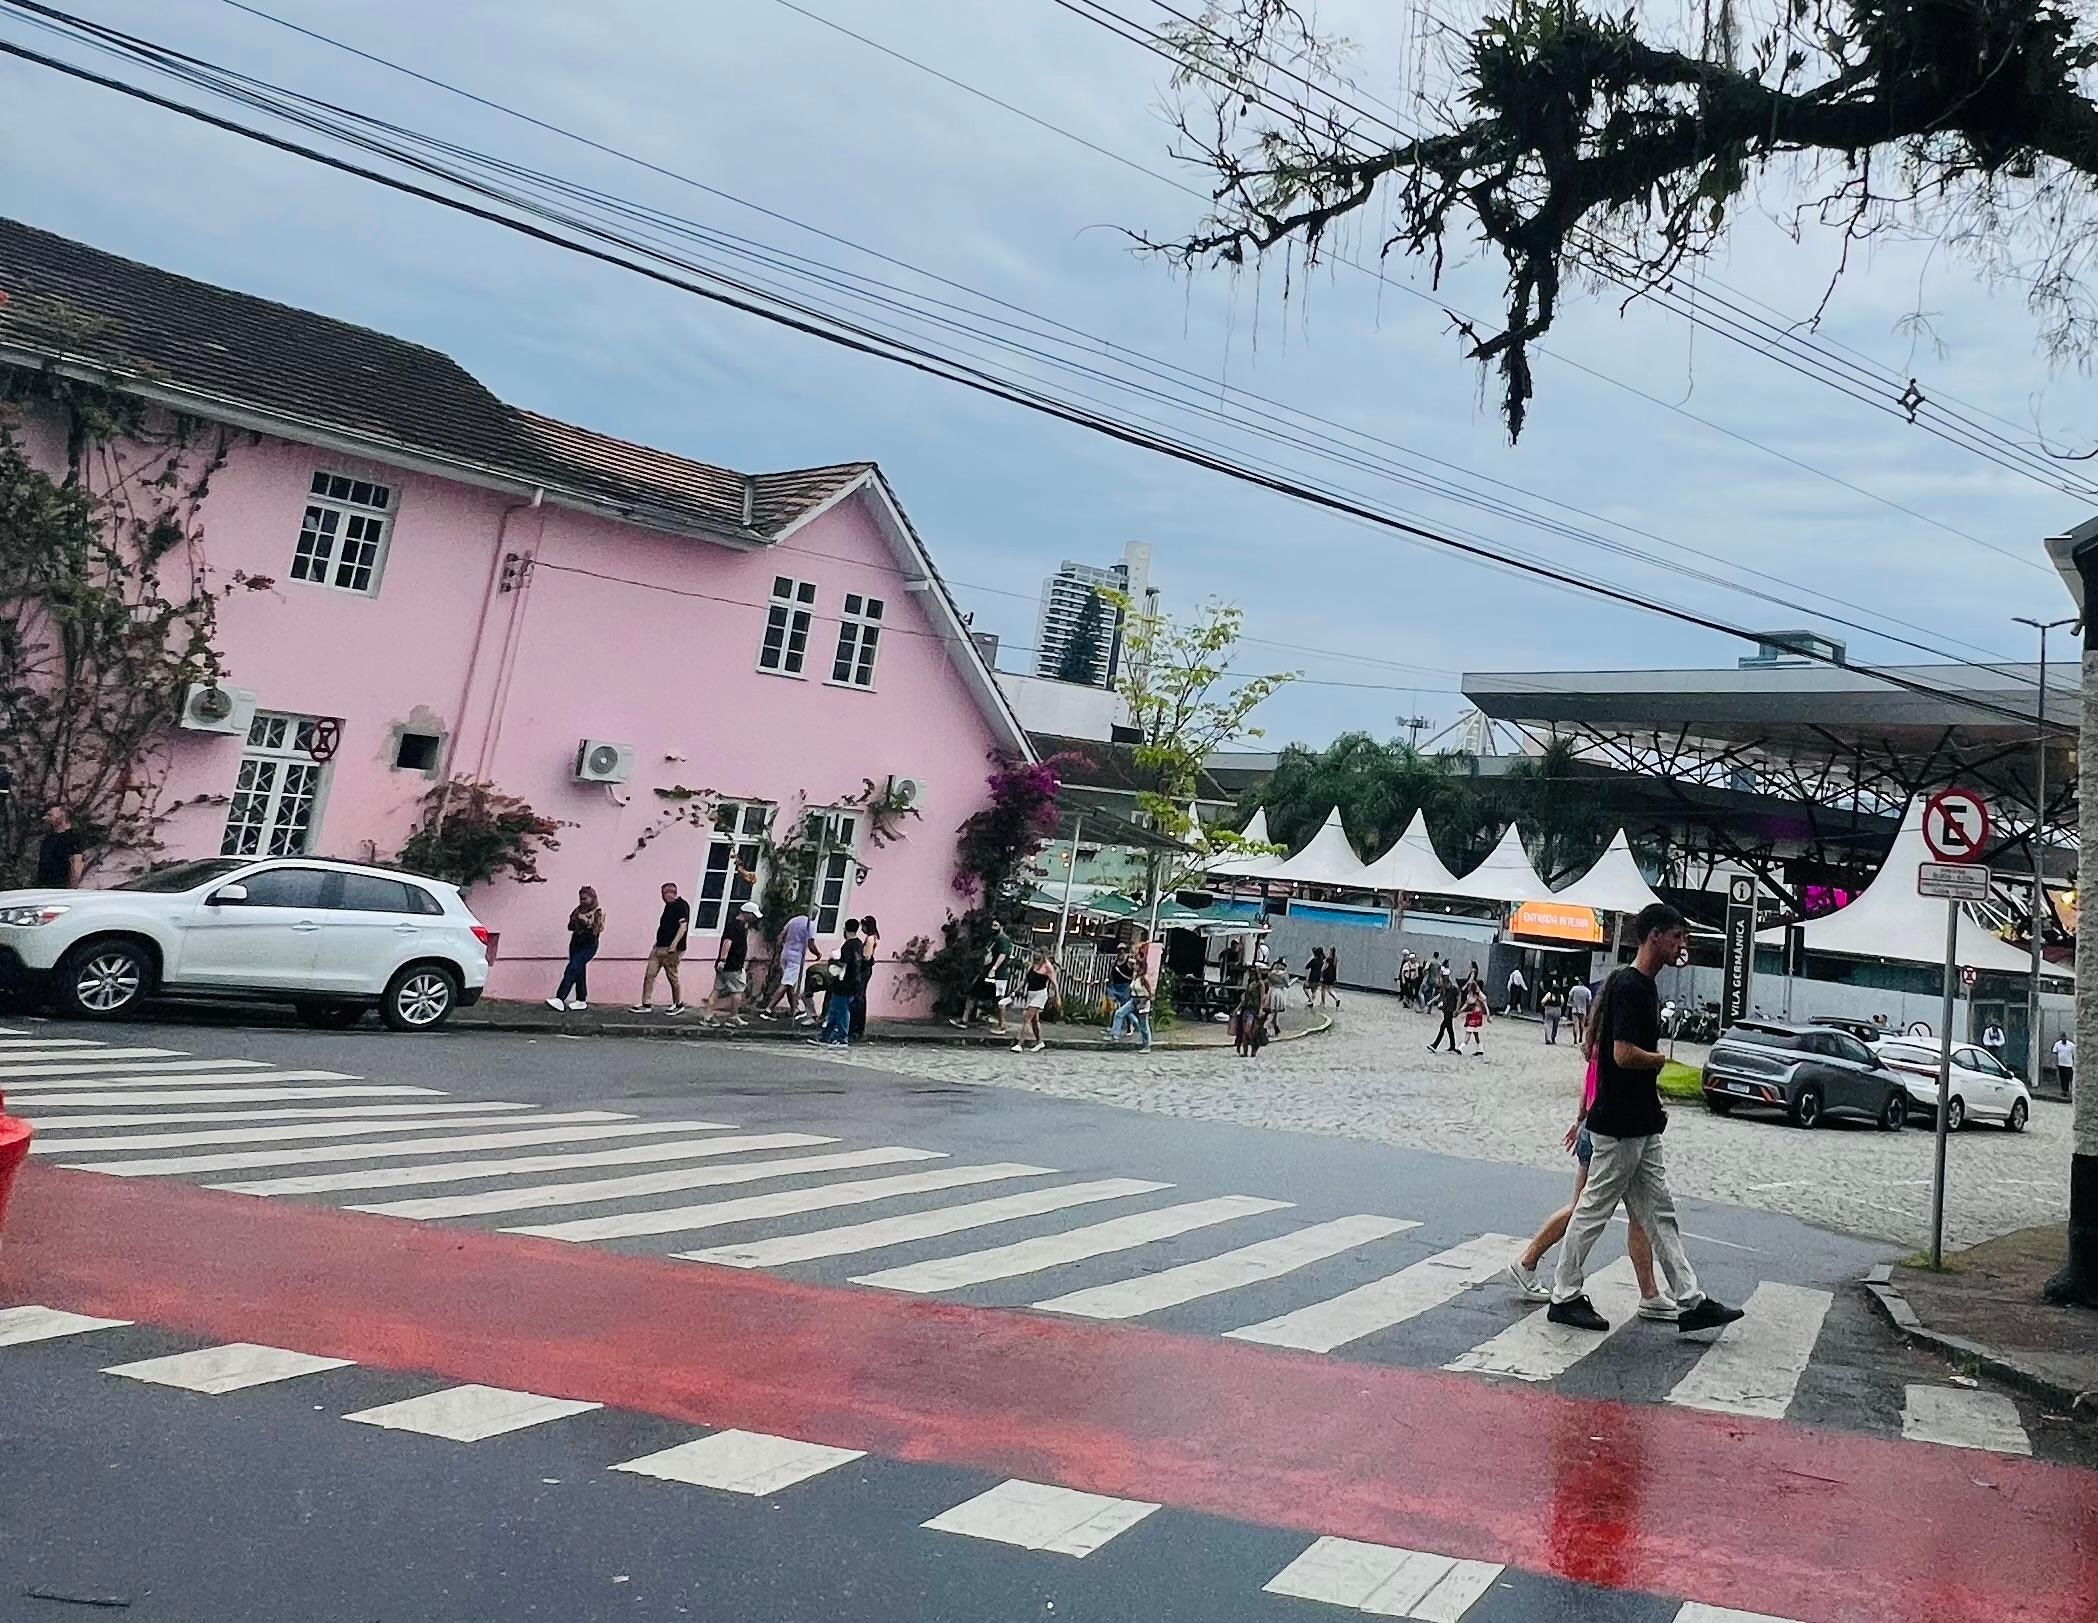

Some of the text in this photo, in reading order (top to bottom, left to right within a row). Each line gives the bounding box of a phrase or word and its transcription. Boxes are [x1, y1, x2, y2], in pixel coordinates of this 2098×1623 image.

[1942, 805, 1968, 847] E
[1523, 911, 1558, 926] ENTRADA
[1730, 990, 1742, 1017] VILA
